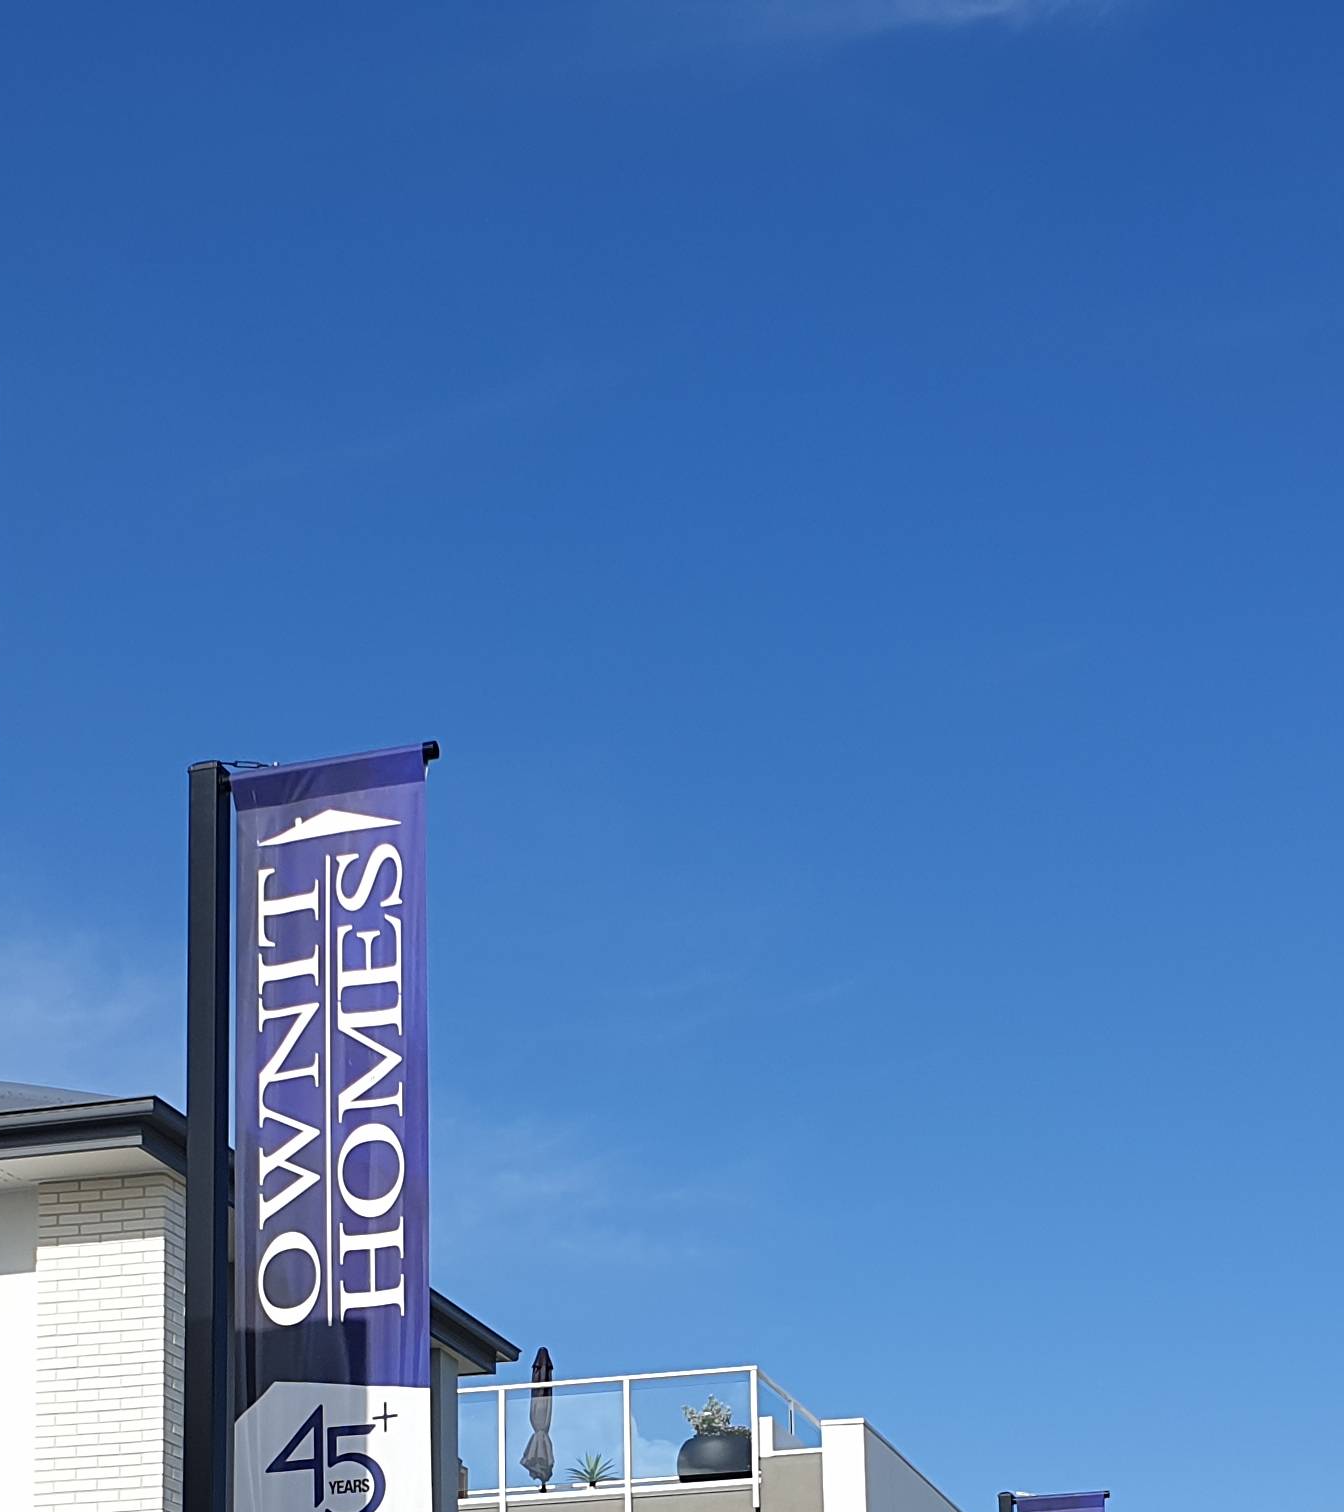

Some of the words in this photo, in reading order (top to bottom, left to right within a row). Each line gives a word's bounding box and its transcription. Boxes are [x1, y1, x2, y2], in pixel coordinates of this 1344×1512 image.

[257, 867, 321, 1328] OWNIT
[338, 842, 406, 1323] HOMES
[328, 1478, 371, 1496] YEARS
